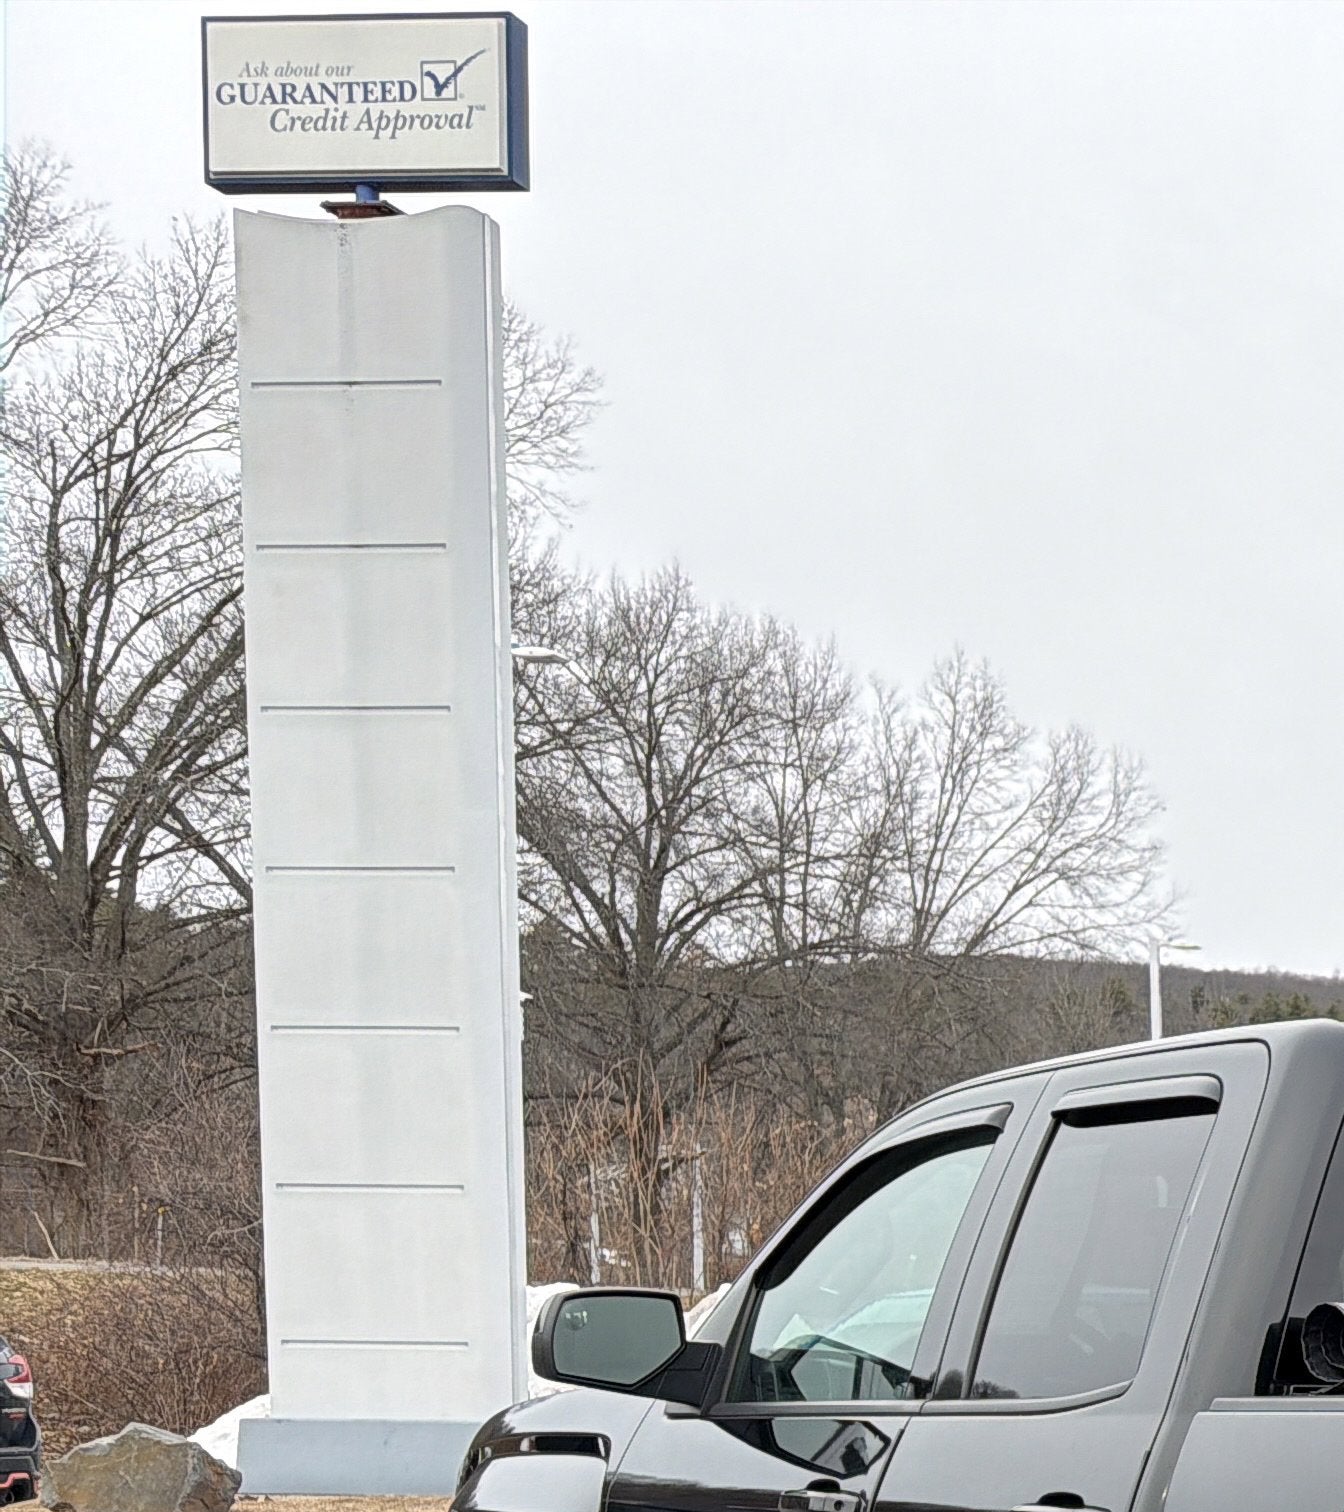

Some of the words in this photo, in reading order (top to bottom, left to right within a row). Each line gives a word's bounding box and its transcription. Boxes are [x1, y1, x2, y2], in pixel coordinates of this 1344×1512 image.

[238, 61, 269, 78] Ask
[274, 61, 320, 78] about
[324, 64, 354, 77] our
[215, 80, 418, 106] GUARANTEED
[269, 107, 349, 133] Credit
[353, 104, 474, 140] Approval
